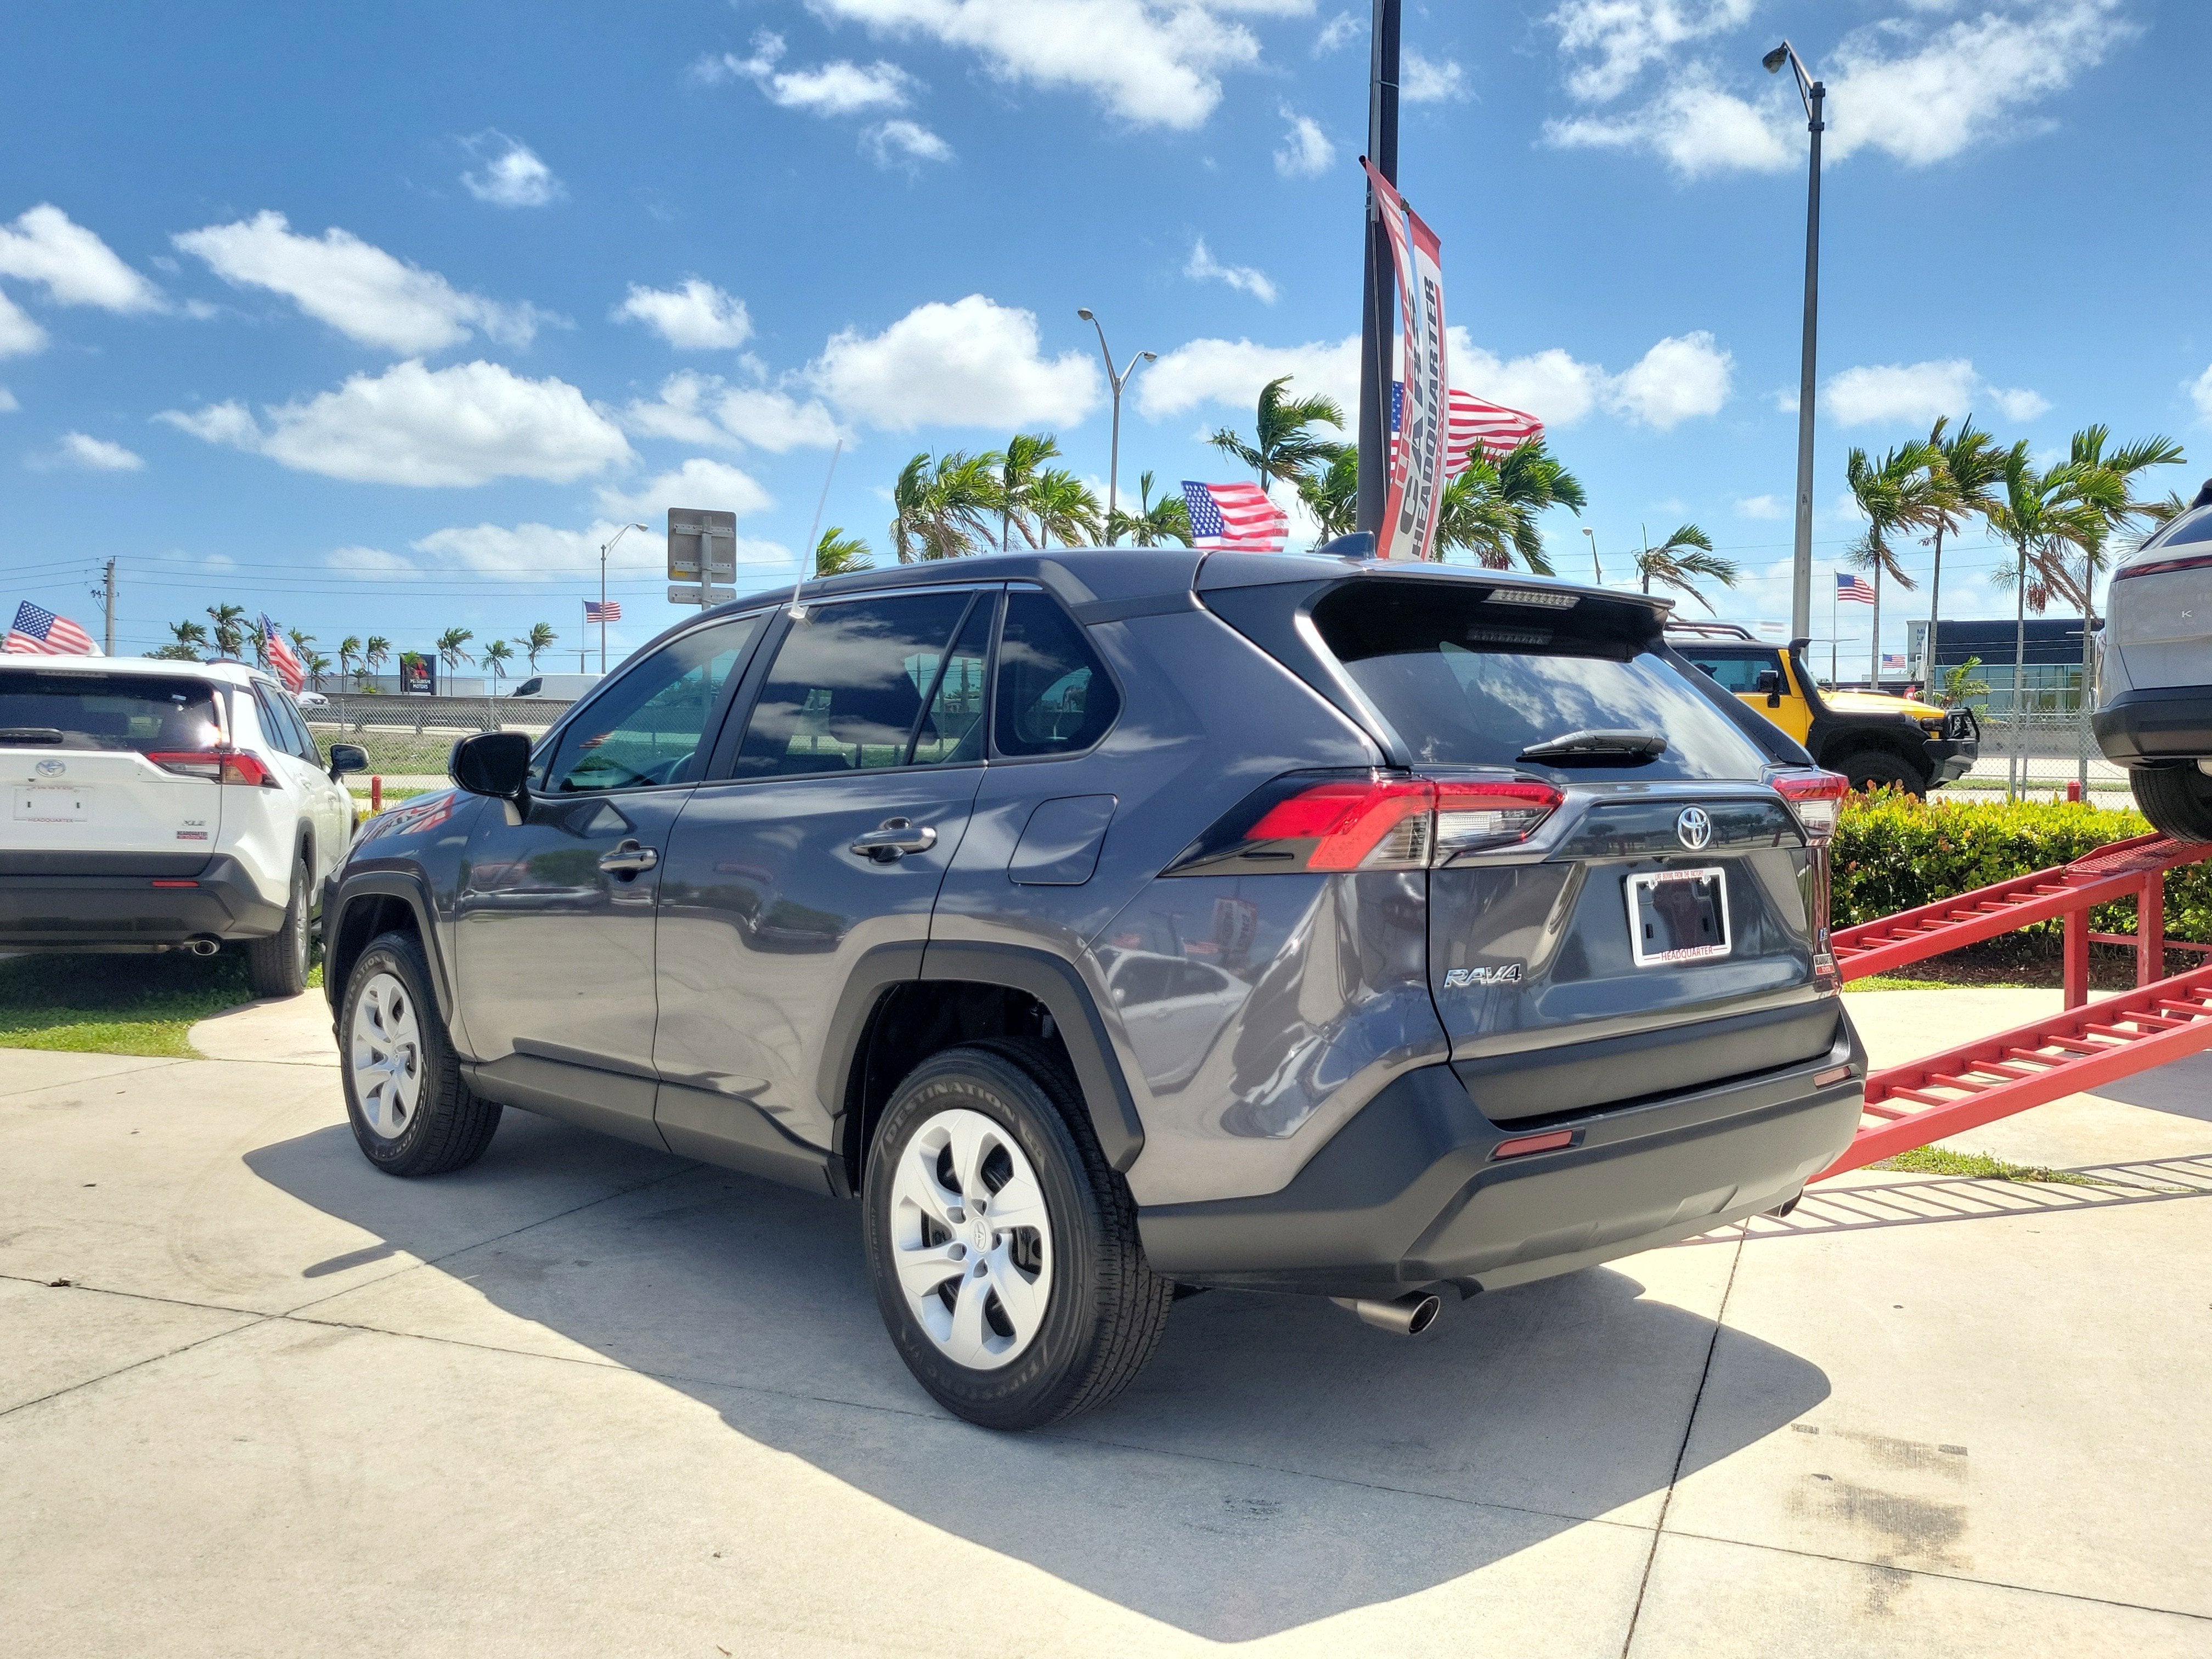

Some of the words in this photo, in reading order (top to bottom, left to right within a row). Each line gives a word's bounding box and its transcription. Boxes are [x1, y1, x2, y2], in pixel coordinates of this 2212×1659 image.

[1395, 298, 1414, 489] USED
[1400, 286, 1423, 534] CARS
[1412, 276, 1438, 556] HEADQUARTER
[1435, 359, 1445, 460] TOYOTA
[1443, 963, 1522, 989] RAV4
[1661, 946, 1713, 961] HEADQUARTER
[884, 1081, 1016, 1144] DESTINATION
